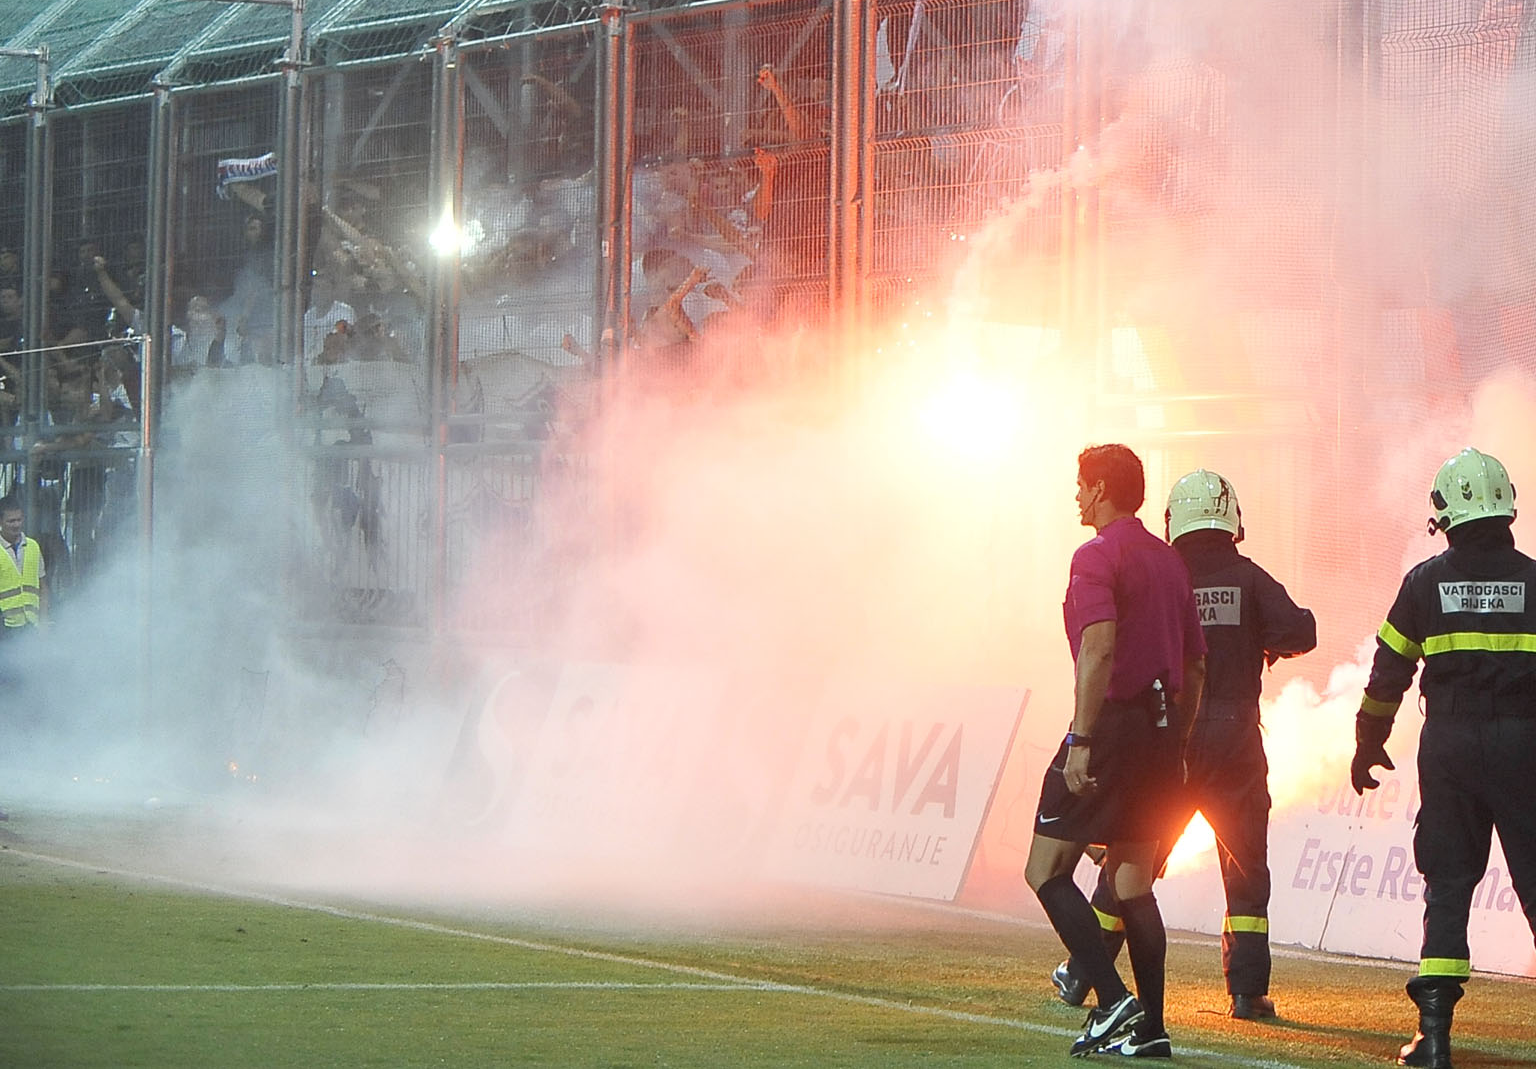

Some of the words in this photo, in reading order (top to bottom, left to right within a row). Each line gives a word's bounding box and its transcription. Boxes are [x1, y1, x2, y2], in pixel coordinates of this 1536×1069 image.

[1442, 585, 1522, 596] VATROGASCI
[1461, 598, 1504, 609] RIJEKA
[810, 715, 963, 819] SAVA
[794, 823, 948, 866] OSIGURANJE
[1291, 836, 1374, 897] Erste
